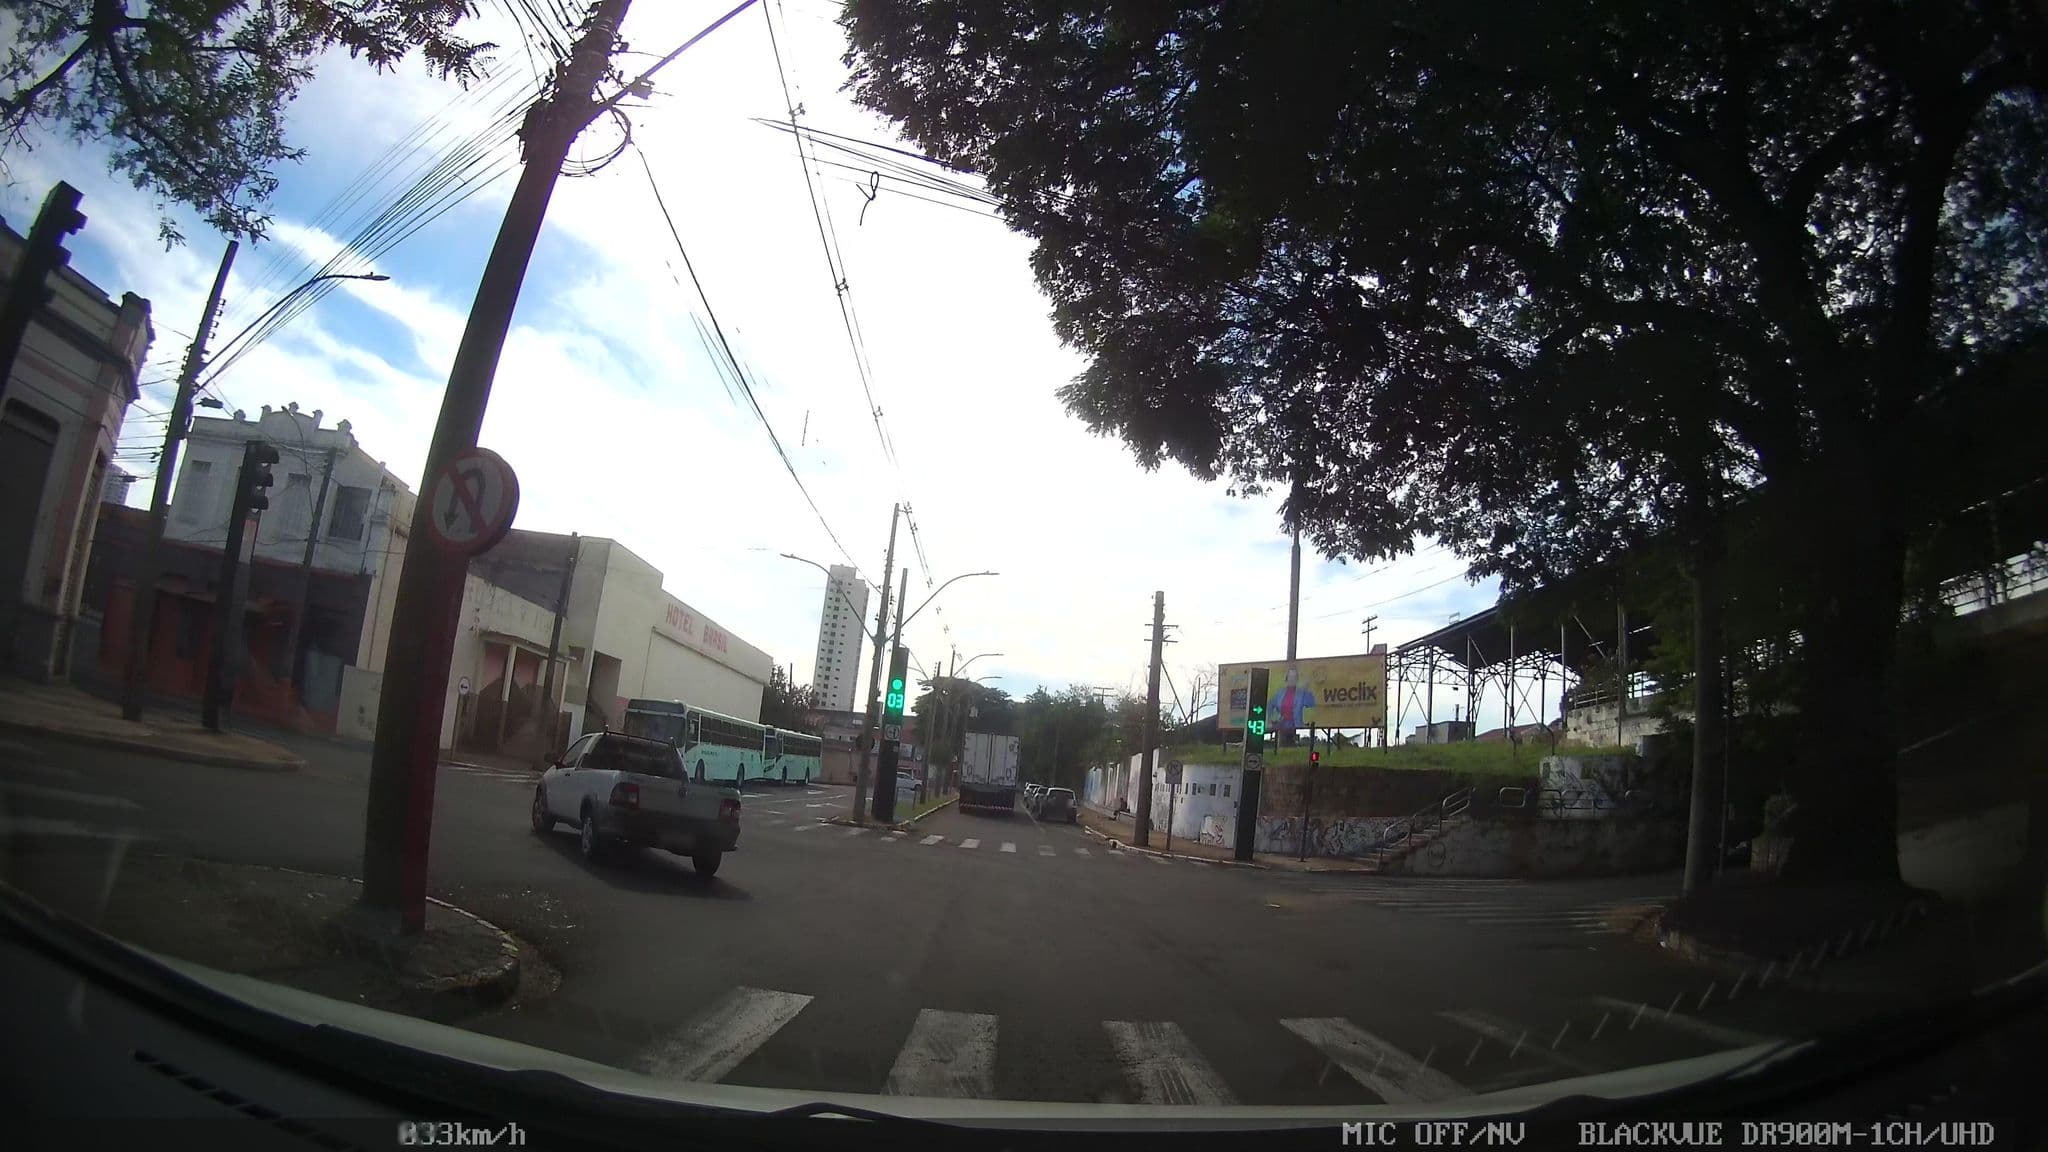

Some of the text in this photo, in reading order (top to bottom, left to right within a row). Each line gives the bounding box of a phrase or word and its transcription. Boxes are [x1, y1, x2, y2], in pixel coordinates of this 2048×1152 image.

[666, 602, 696, 635] HOTEL
[887, 692, 904, 708] 03
[1323, 681, 1377, 703] weclix
[1247, 720, 1265, 735] 43
